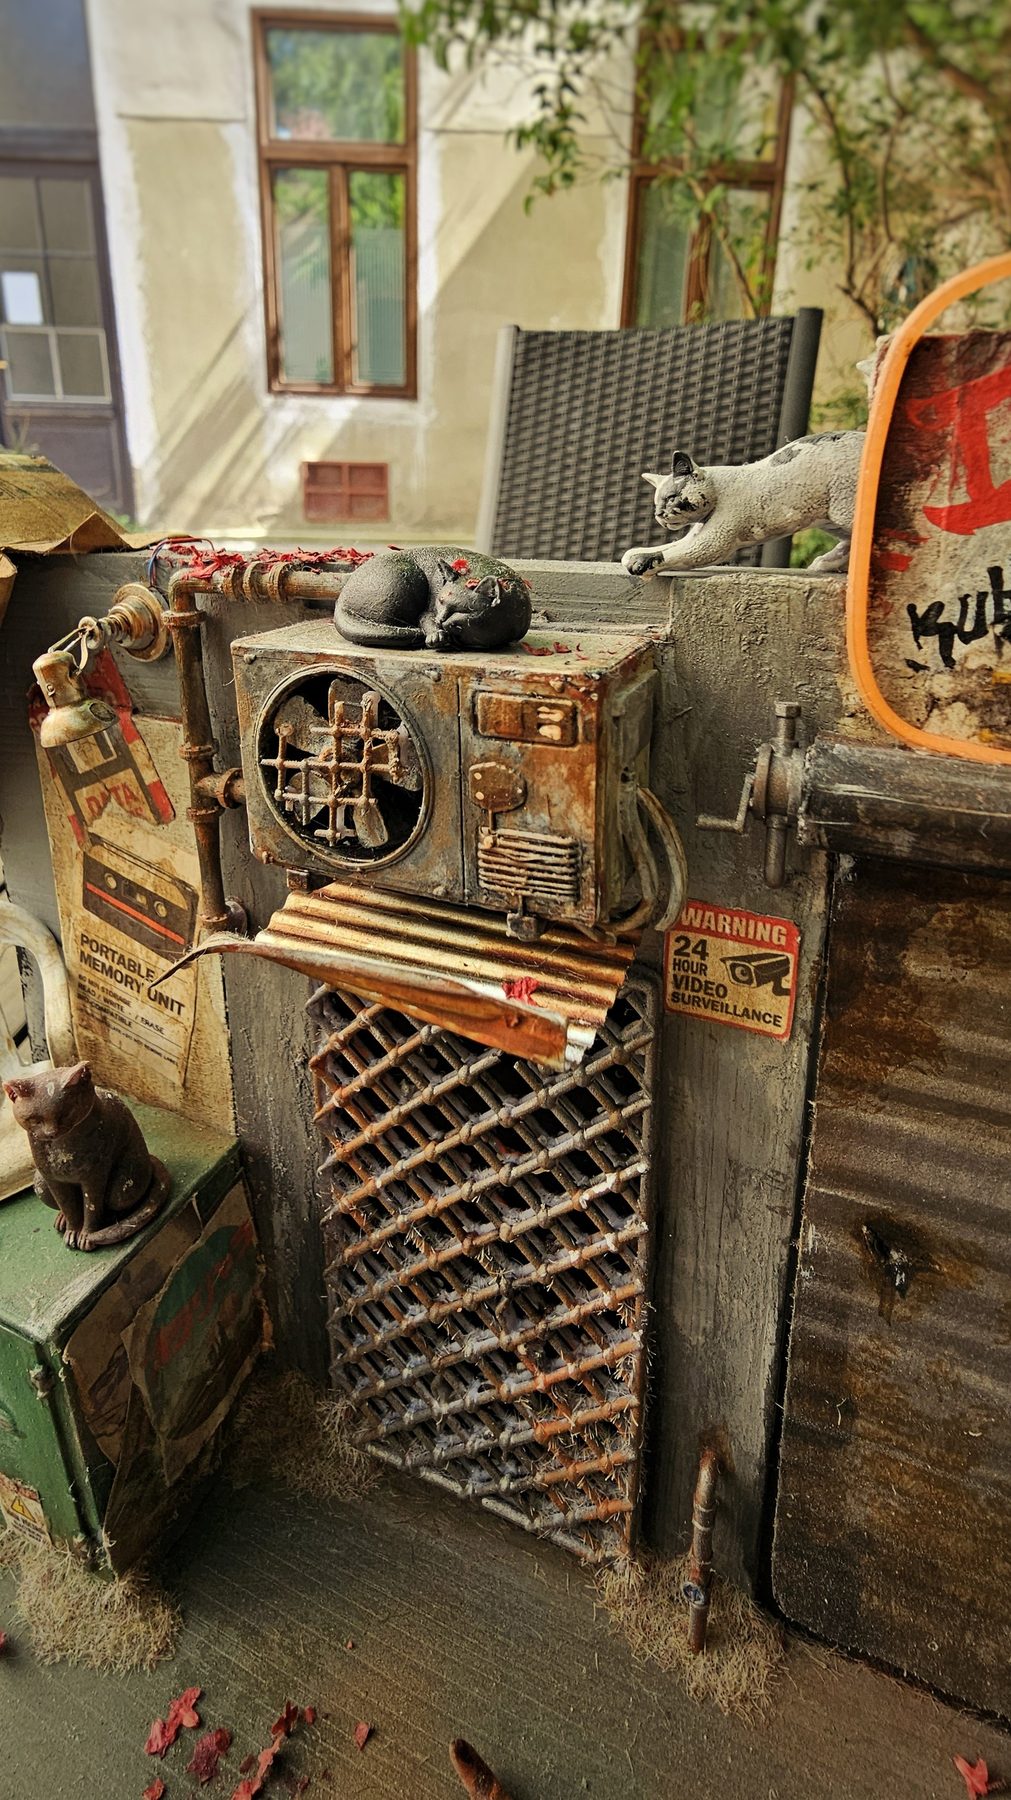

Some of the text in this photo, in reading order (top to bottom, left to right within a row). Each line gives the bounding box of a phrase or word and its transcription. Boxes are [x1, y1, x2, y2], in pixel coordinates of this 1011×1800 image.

[681, 907, 787, 946] WARNING
[80, 934, 155, 983] PORTABLE
[674, 935, 709, 960] 24
[80, 951, 185, 1015] MEMORY UNIT
[673, 958, 708, 976] HOUR
[672, 974, 728, 998] VIDEO
[671, 991, 782, 1028] SURVEILLANCE
